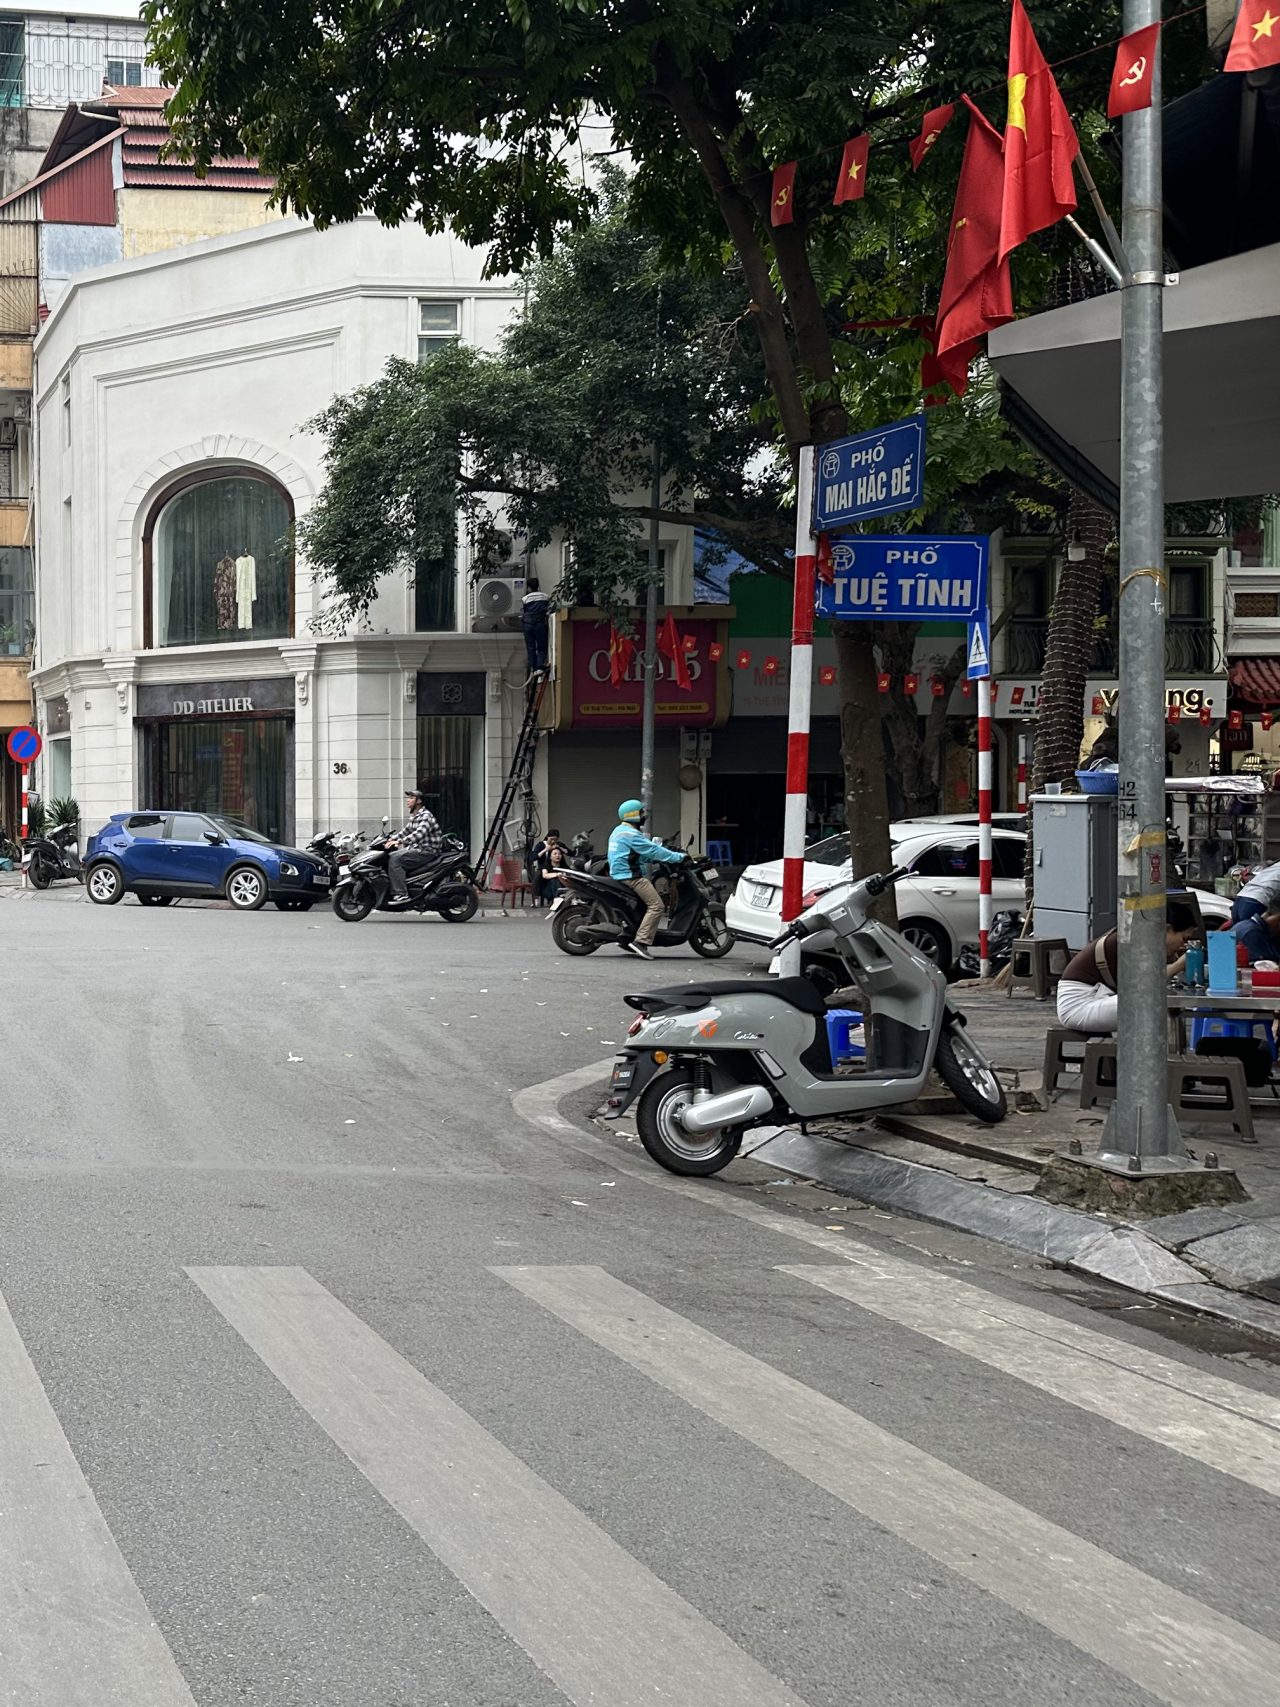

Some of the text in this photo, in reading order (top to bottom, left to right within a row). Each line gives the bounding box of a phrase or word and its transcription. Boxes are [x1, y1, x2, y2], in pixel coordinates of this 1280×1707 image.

[851, 437, 886, 469] PHỐ
[825, 453, 914, 514] MAI HẮC ĐẾ
[886, 544, 940, 565] PHỐ
[832, 572, 972, 612] TUỆ TĨNH
[173, 697, 255, 715] DD ATELIER
